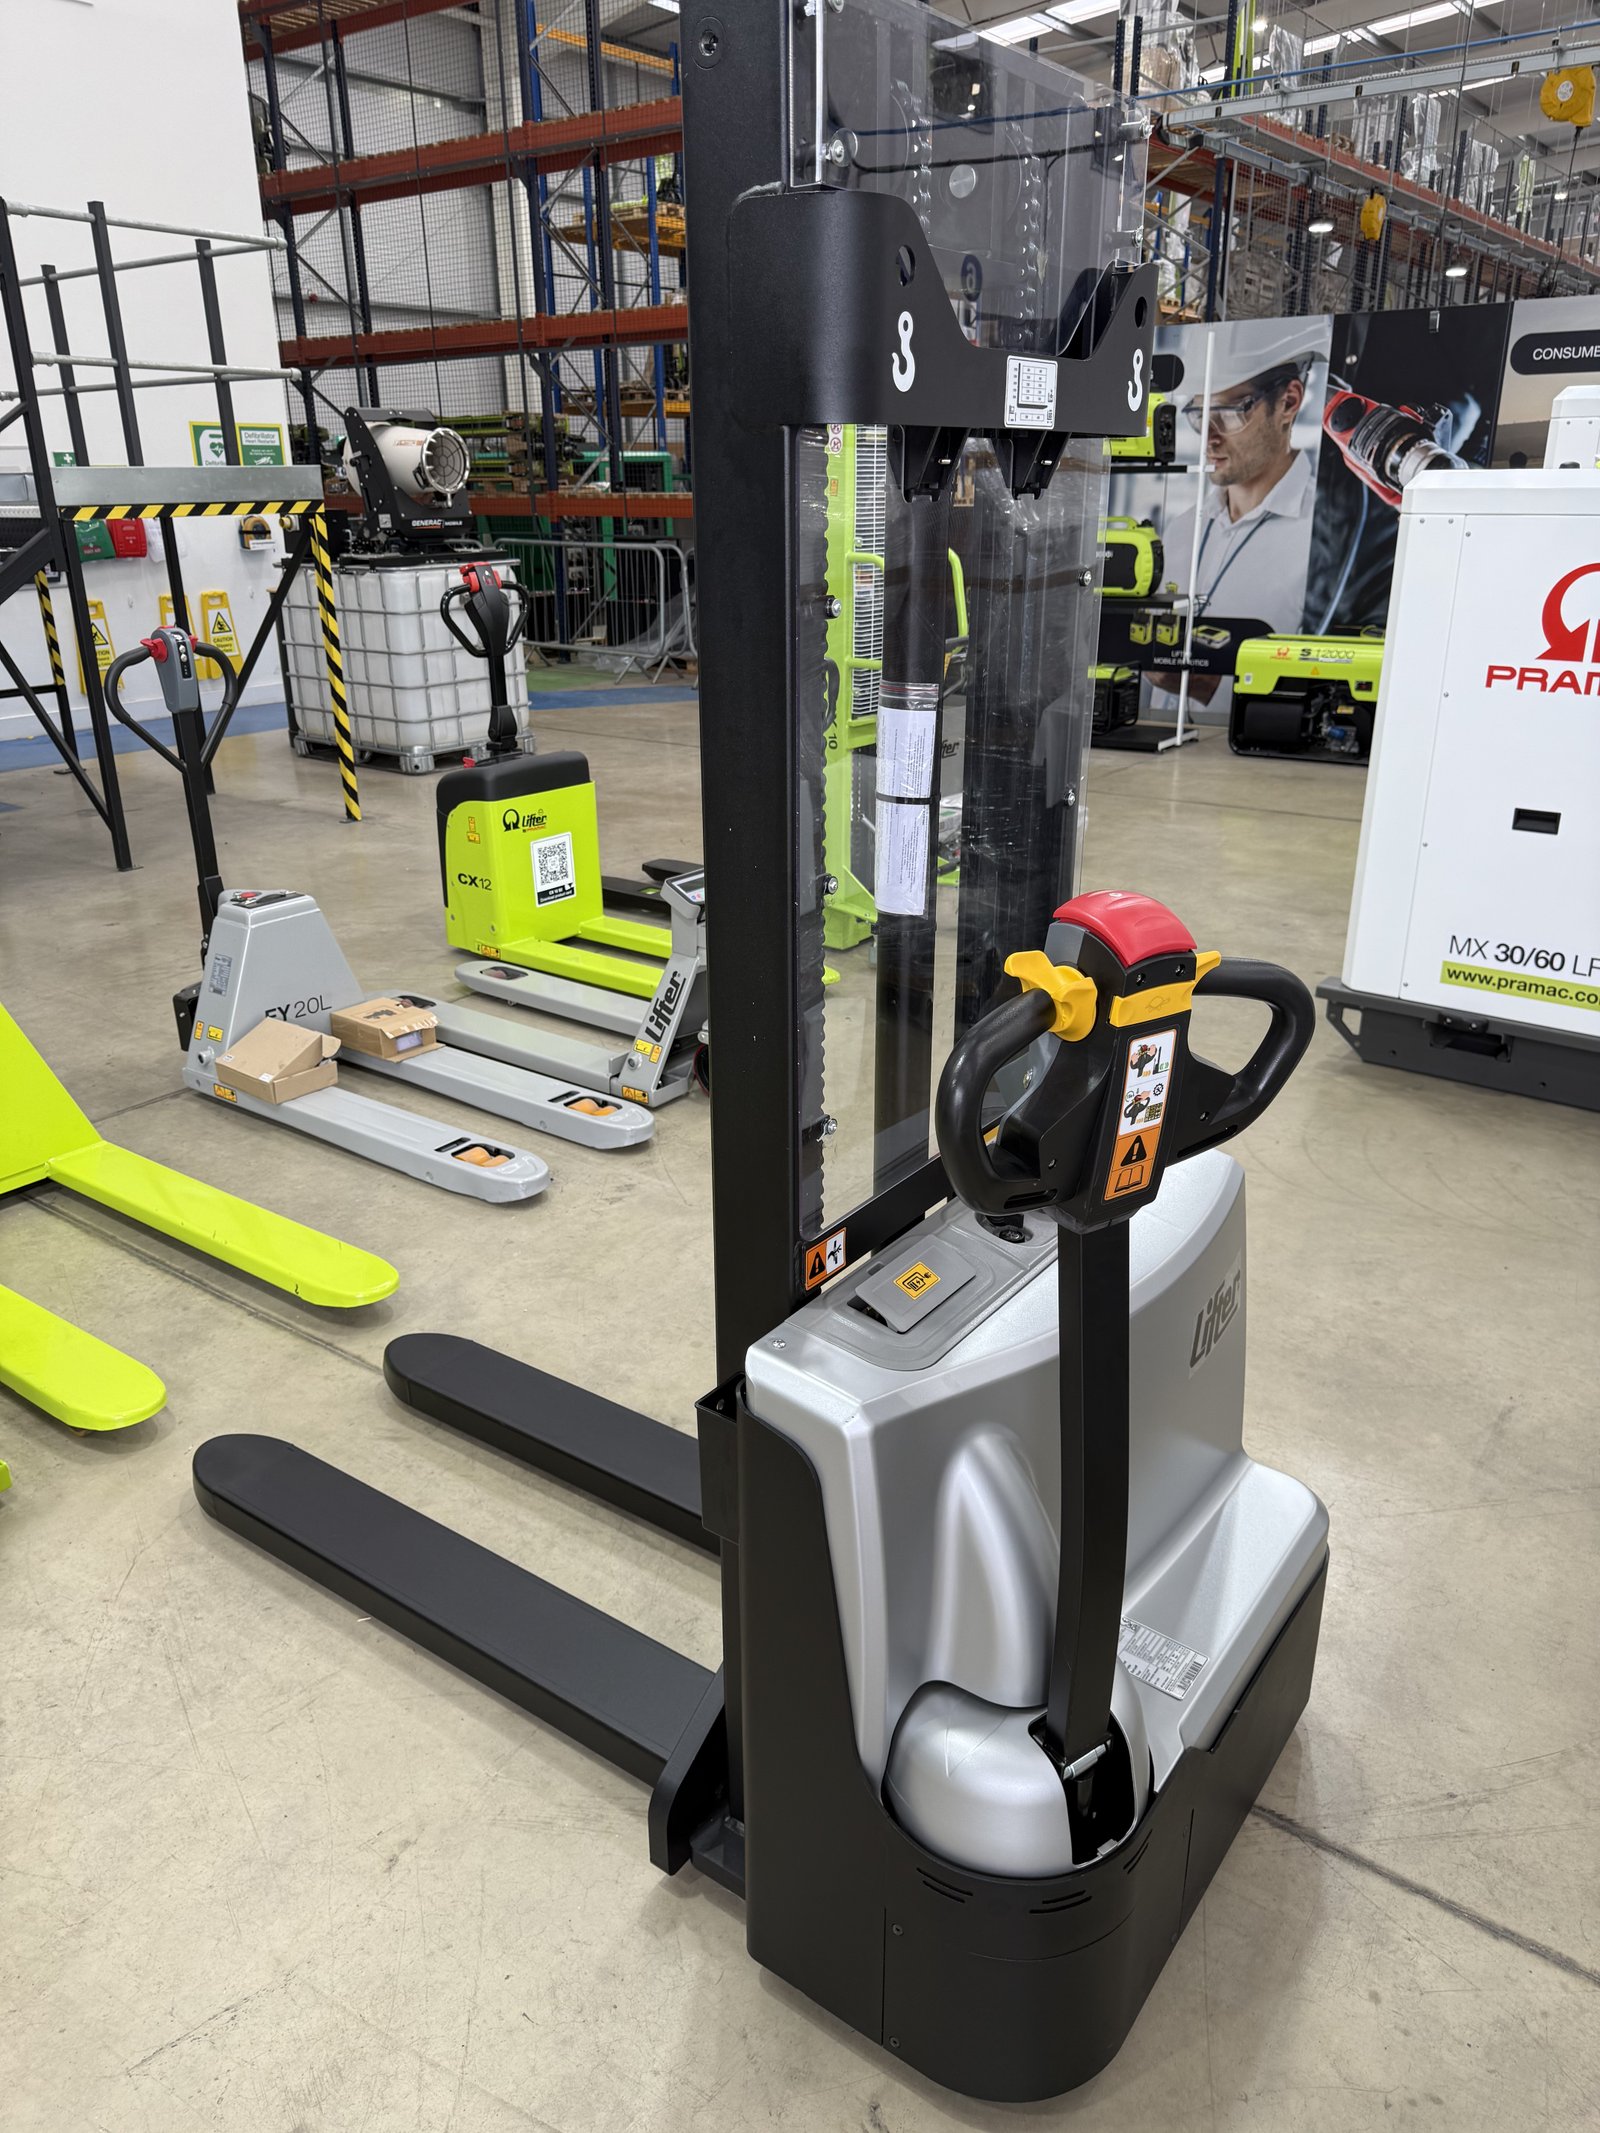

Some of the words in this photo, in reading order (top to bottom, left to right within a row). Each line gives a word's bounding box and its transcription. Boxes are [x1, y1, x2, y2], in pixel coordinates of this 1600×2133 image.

[244, 432, 275, 440] Defibrillator
[411, 519, 442, 527] GENERAC
[1154, 657, 1176, 666] MOBILE
[1177, 658, 1209, 667] ROTICS
[1300, 648, 1312, 657] S
[522, 813, 547, 828] Lifter
[1449, 935, 1489, 960] MX
[1494, 943, 1565, 972] 30/60
[1447, 968, 1600, 1006] www.pramac.co
[294, 994, 333, 1019] 20L
[645, 970, 686, 1043] Lifter
[1190, 1269, 1241, 1369] Lifter
